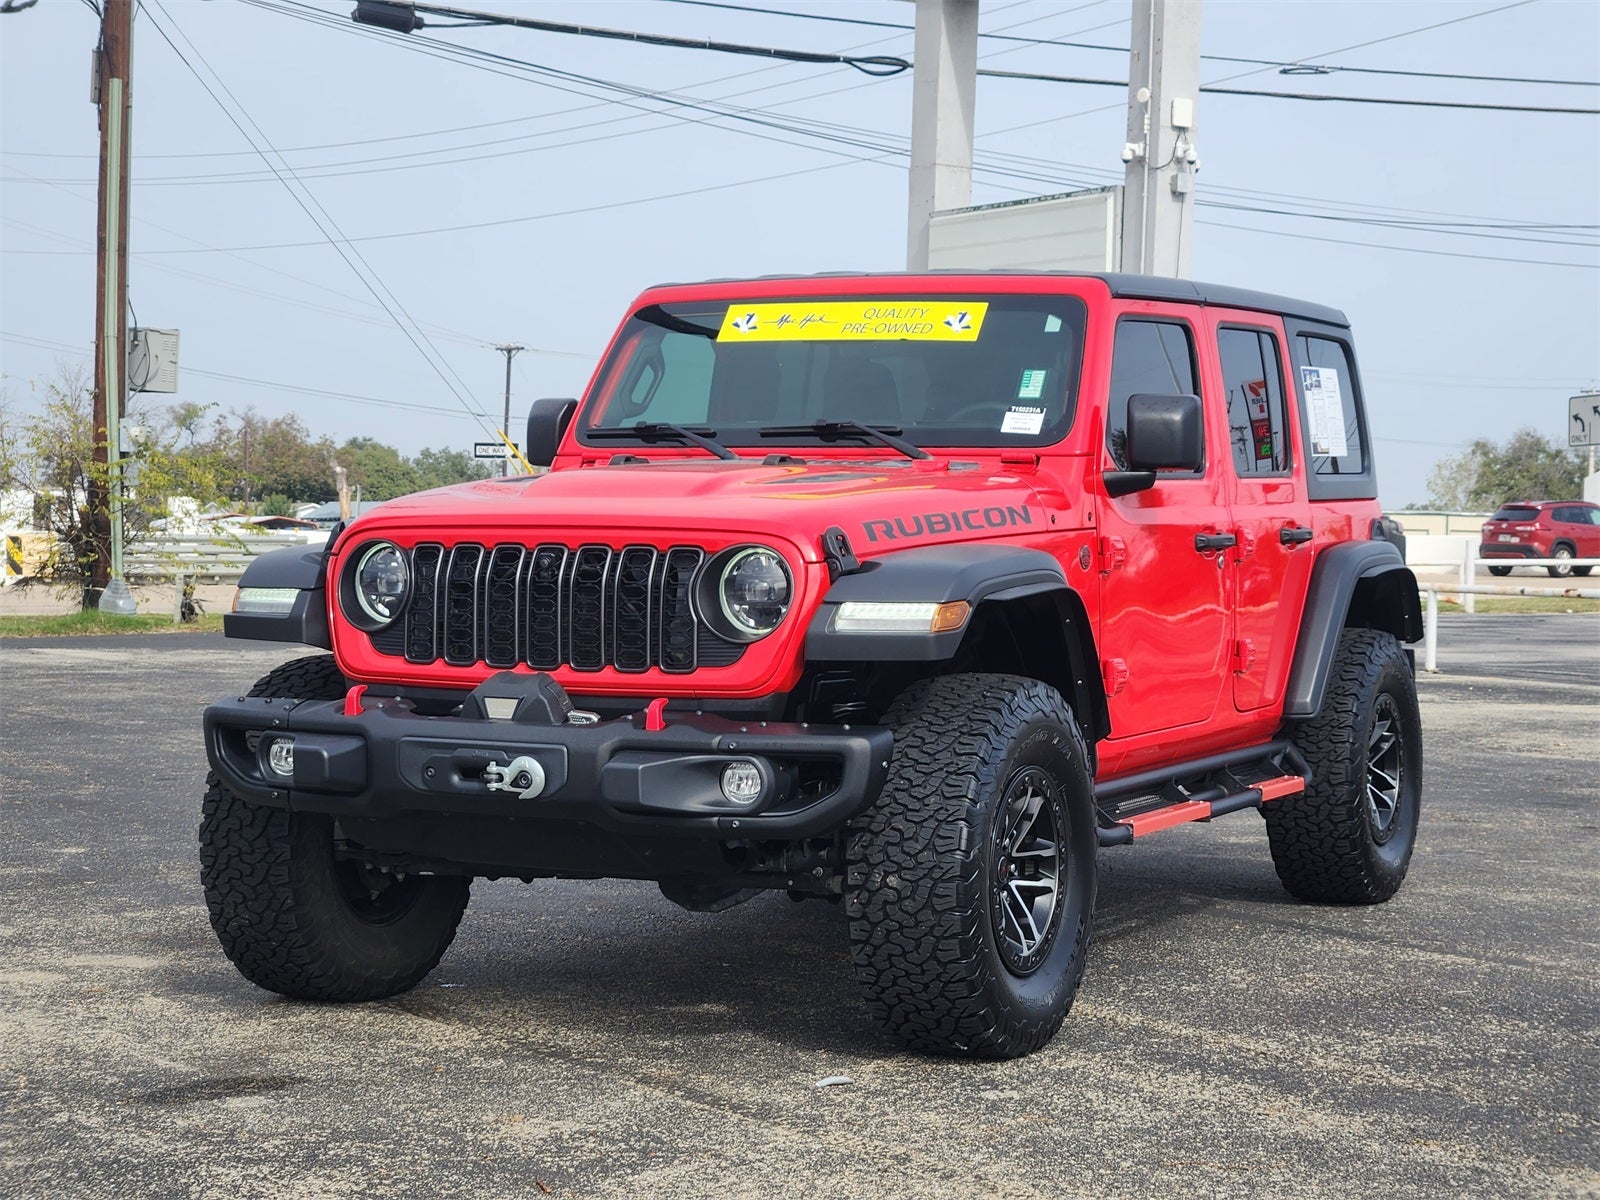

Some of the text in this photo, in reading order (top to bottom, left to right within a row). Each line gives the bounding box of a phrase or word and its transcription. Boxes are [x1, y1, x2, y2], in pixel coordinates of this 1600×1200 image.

[863, 307, 930, 320] QUALITY
[841, 322, 933, 335] PRE-OWNED
[1571, 434, 1588, 443] ONLY
[862, 505, 1032, 542] RUBICON
